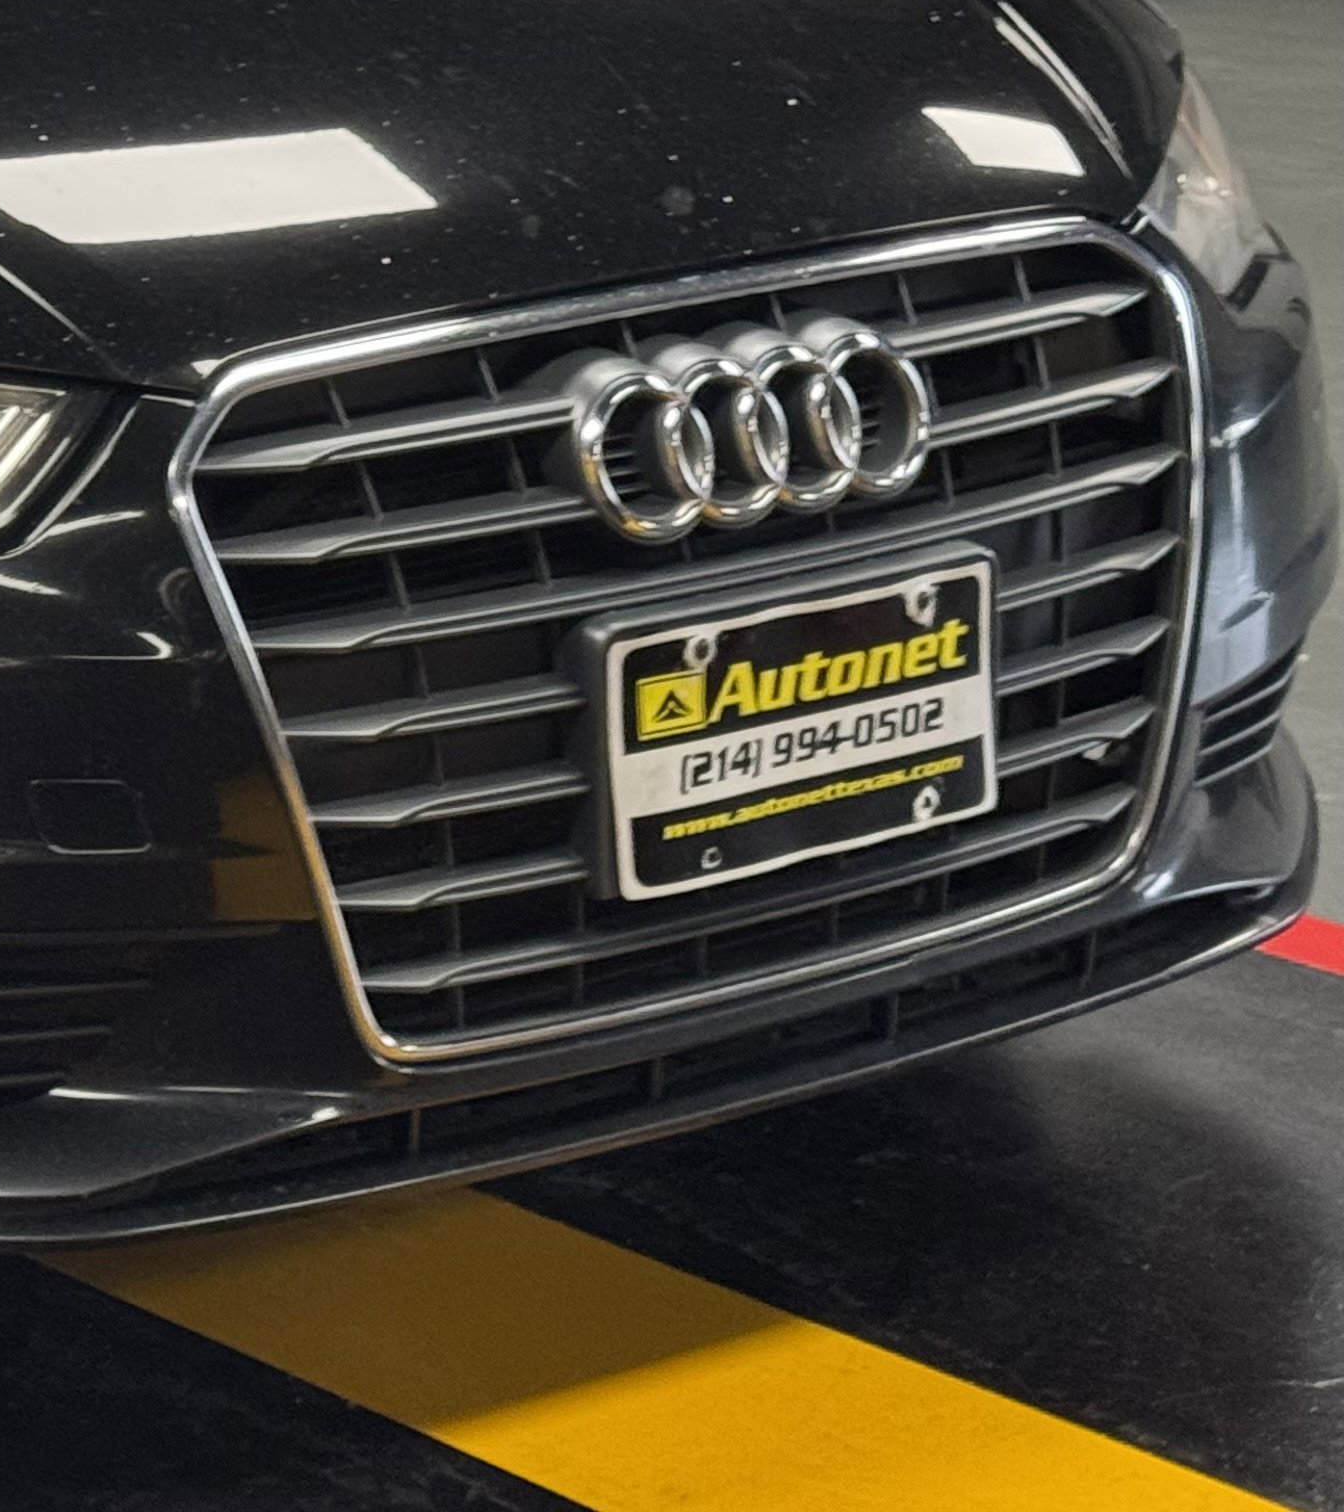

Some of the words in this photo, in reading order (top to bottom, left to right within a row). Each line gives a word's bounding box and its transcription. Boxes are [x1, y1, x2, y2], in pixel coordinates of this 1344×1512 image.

[708, 618, 970, 724] Autonet
[679, 738, 764, 795] (214)
[771, 697, 945, 769] 994-0502
